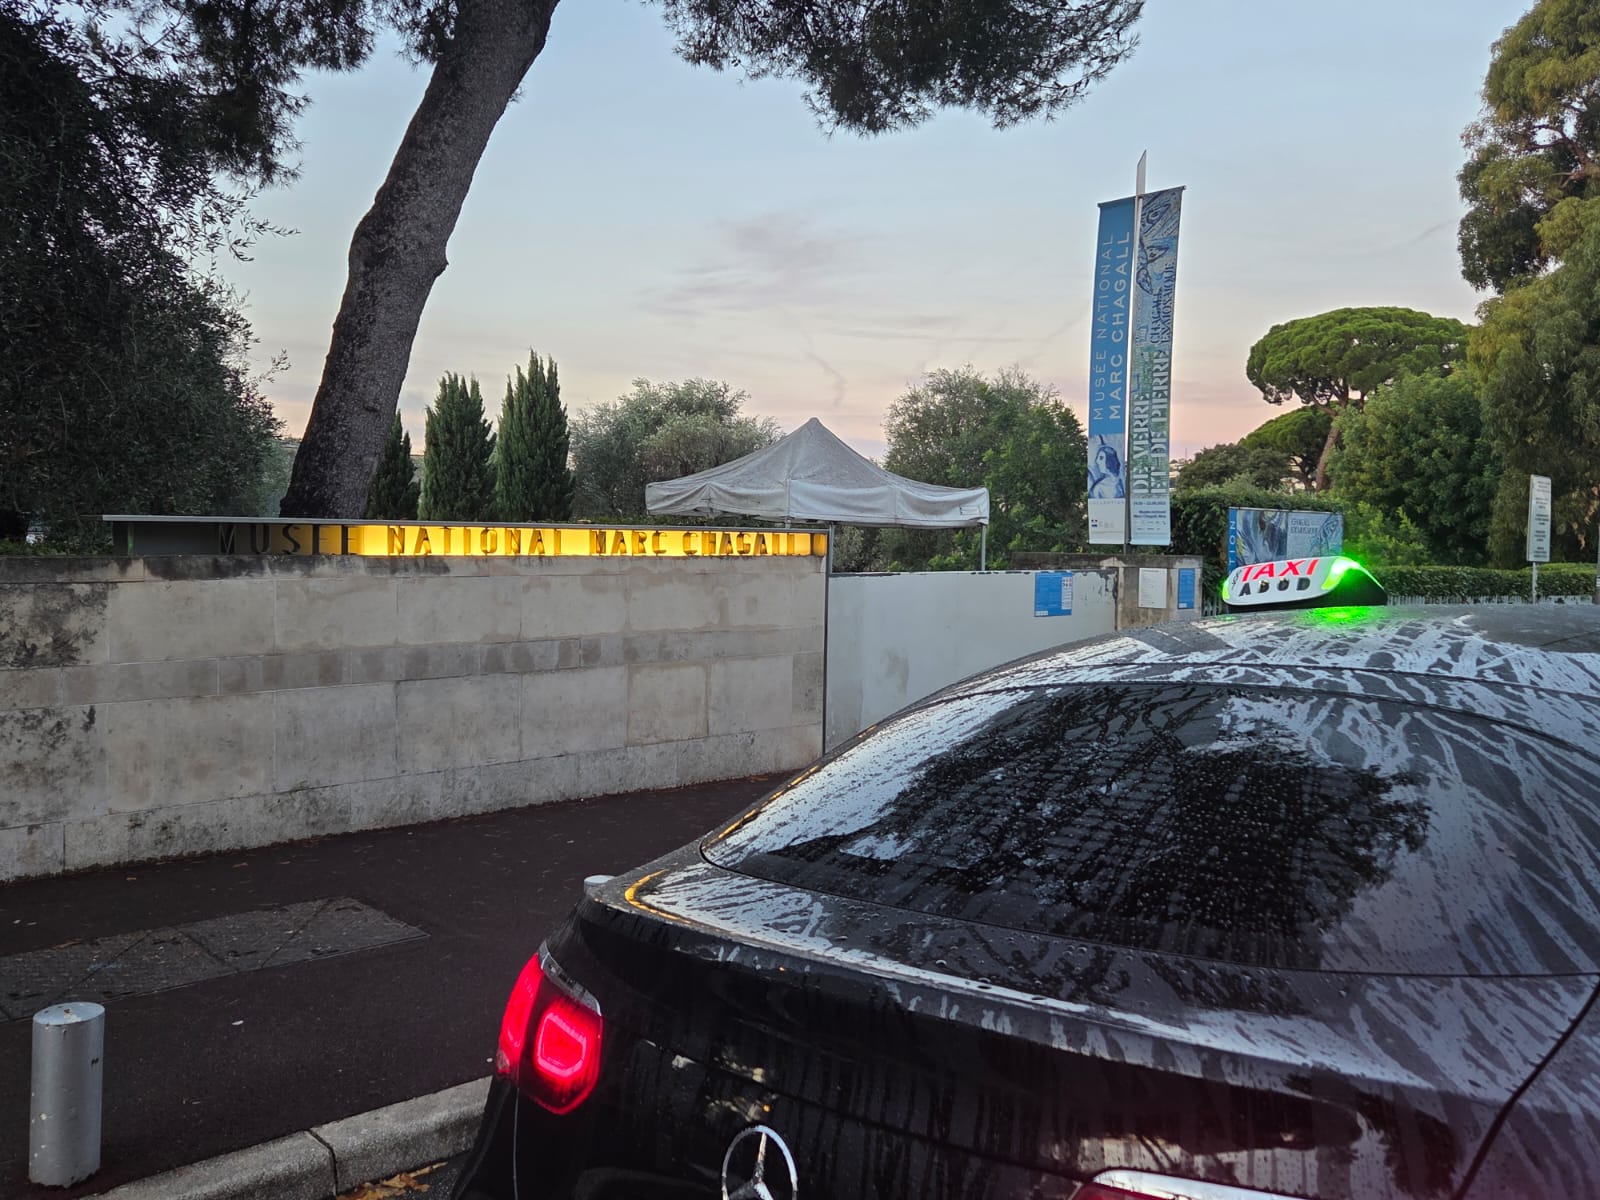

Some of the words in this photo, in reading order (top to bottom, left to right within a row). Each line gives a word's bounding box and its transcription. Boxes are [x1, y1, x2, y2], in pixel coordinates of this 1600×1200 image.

[1097, 235, 1113, 339] NATIONAL
[1111, 231, 1130, 343] CHAGALL
[1092, 350, 1106, 420] MUSÉE
[1109, 354, 1123, 420] MARC
[1151, 350, 1169, 423] PIERRE
[1133, 393, 1150, 460] VERRE
[1151, 431, 1168, 458] DE
[1132, 466, 1149, 494] DE
[1150, 466, 1167, 494] ET
[387, 525, 563, 556] NATIONAL
[589, 530, 668, 556] MARC
[682, 531, 797, 556] CHAGALL
[1242, 559, 1319, 582] TAXI
